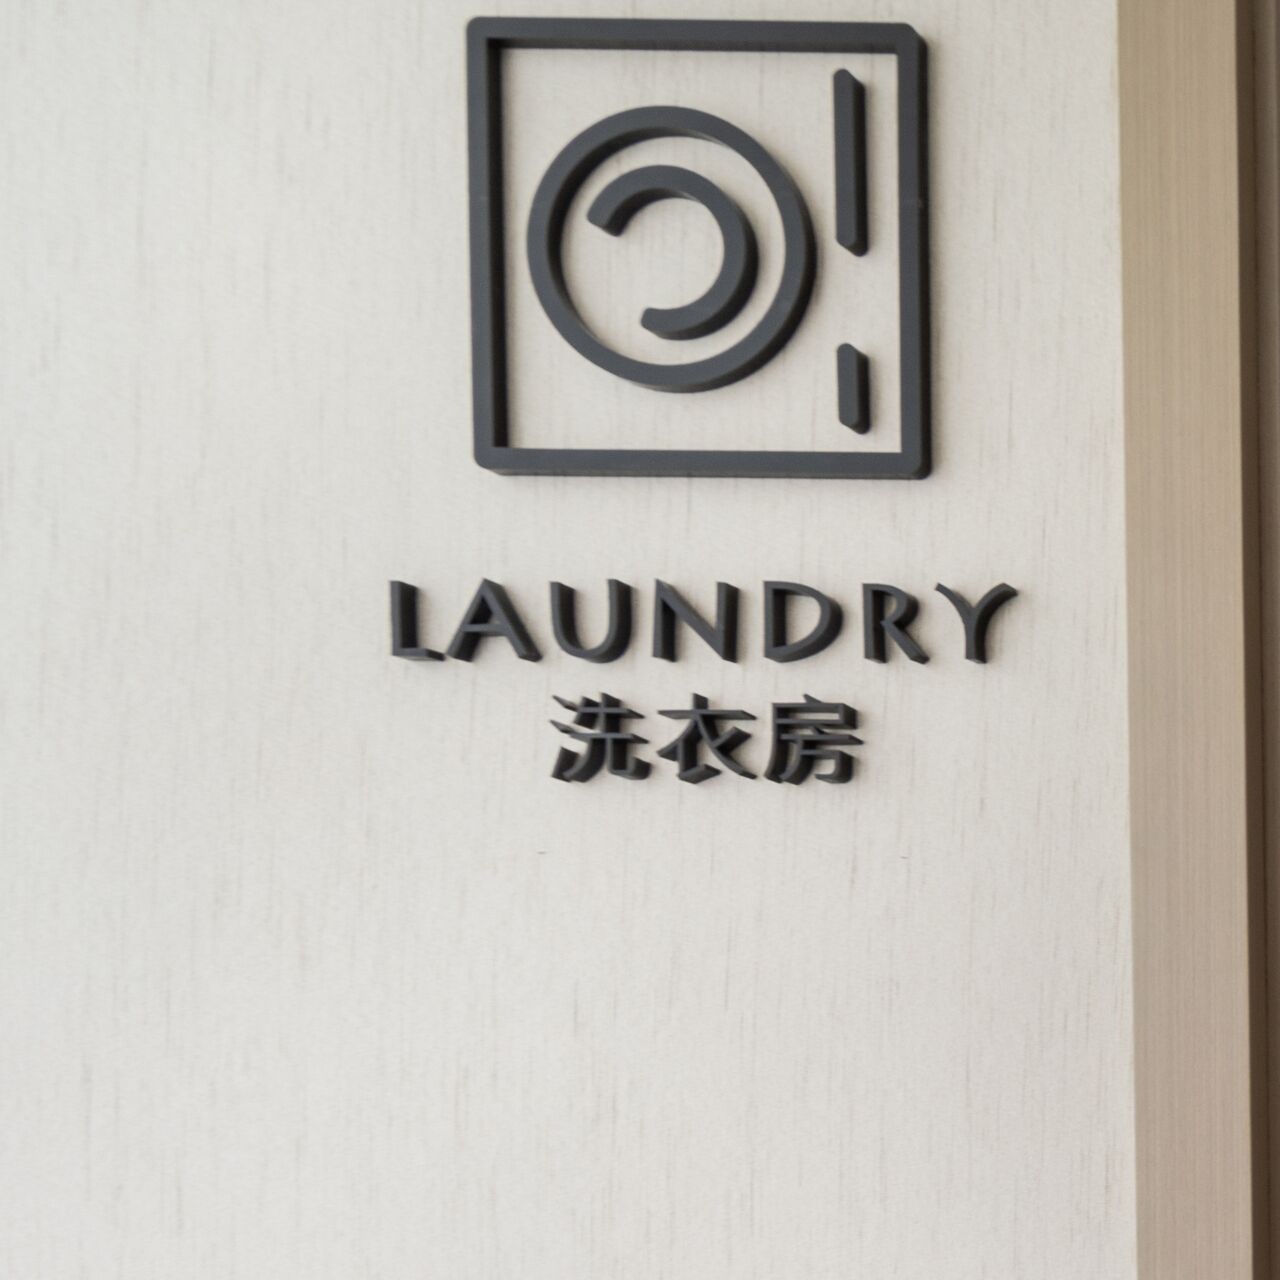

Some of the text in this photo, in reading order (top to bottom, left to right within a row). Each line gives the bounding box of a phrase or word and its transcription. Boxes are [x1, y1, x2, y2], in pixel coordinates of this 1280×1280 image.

[388, 578, 1020, 666] LAUNDRY
[549, 692, 866, 786] 洗衣房
